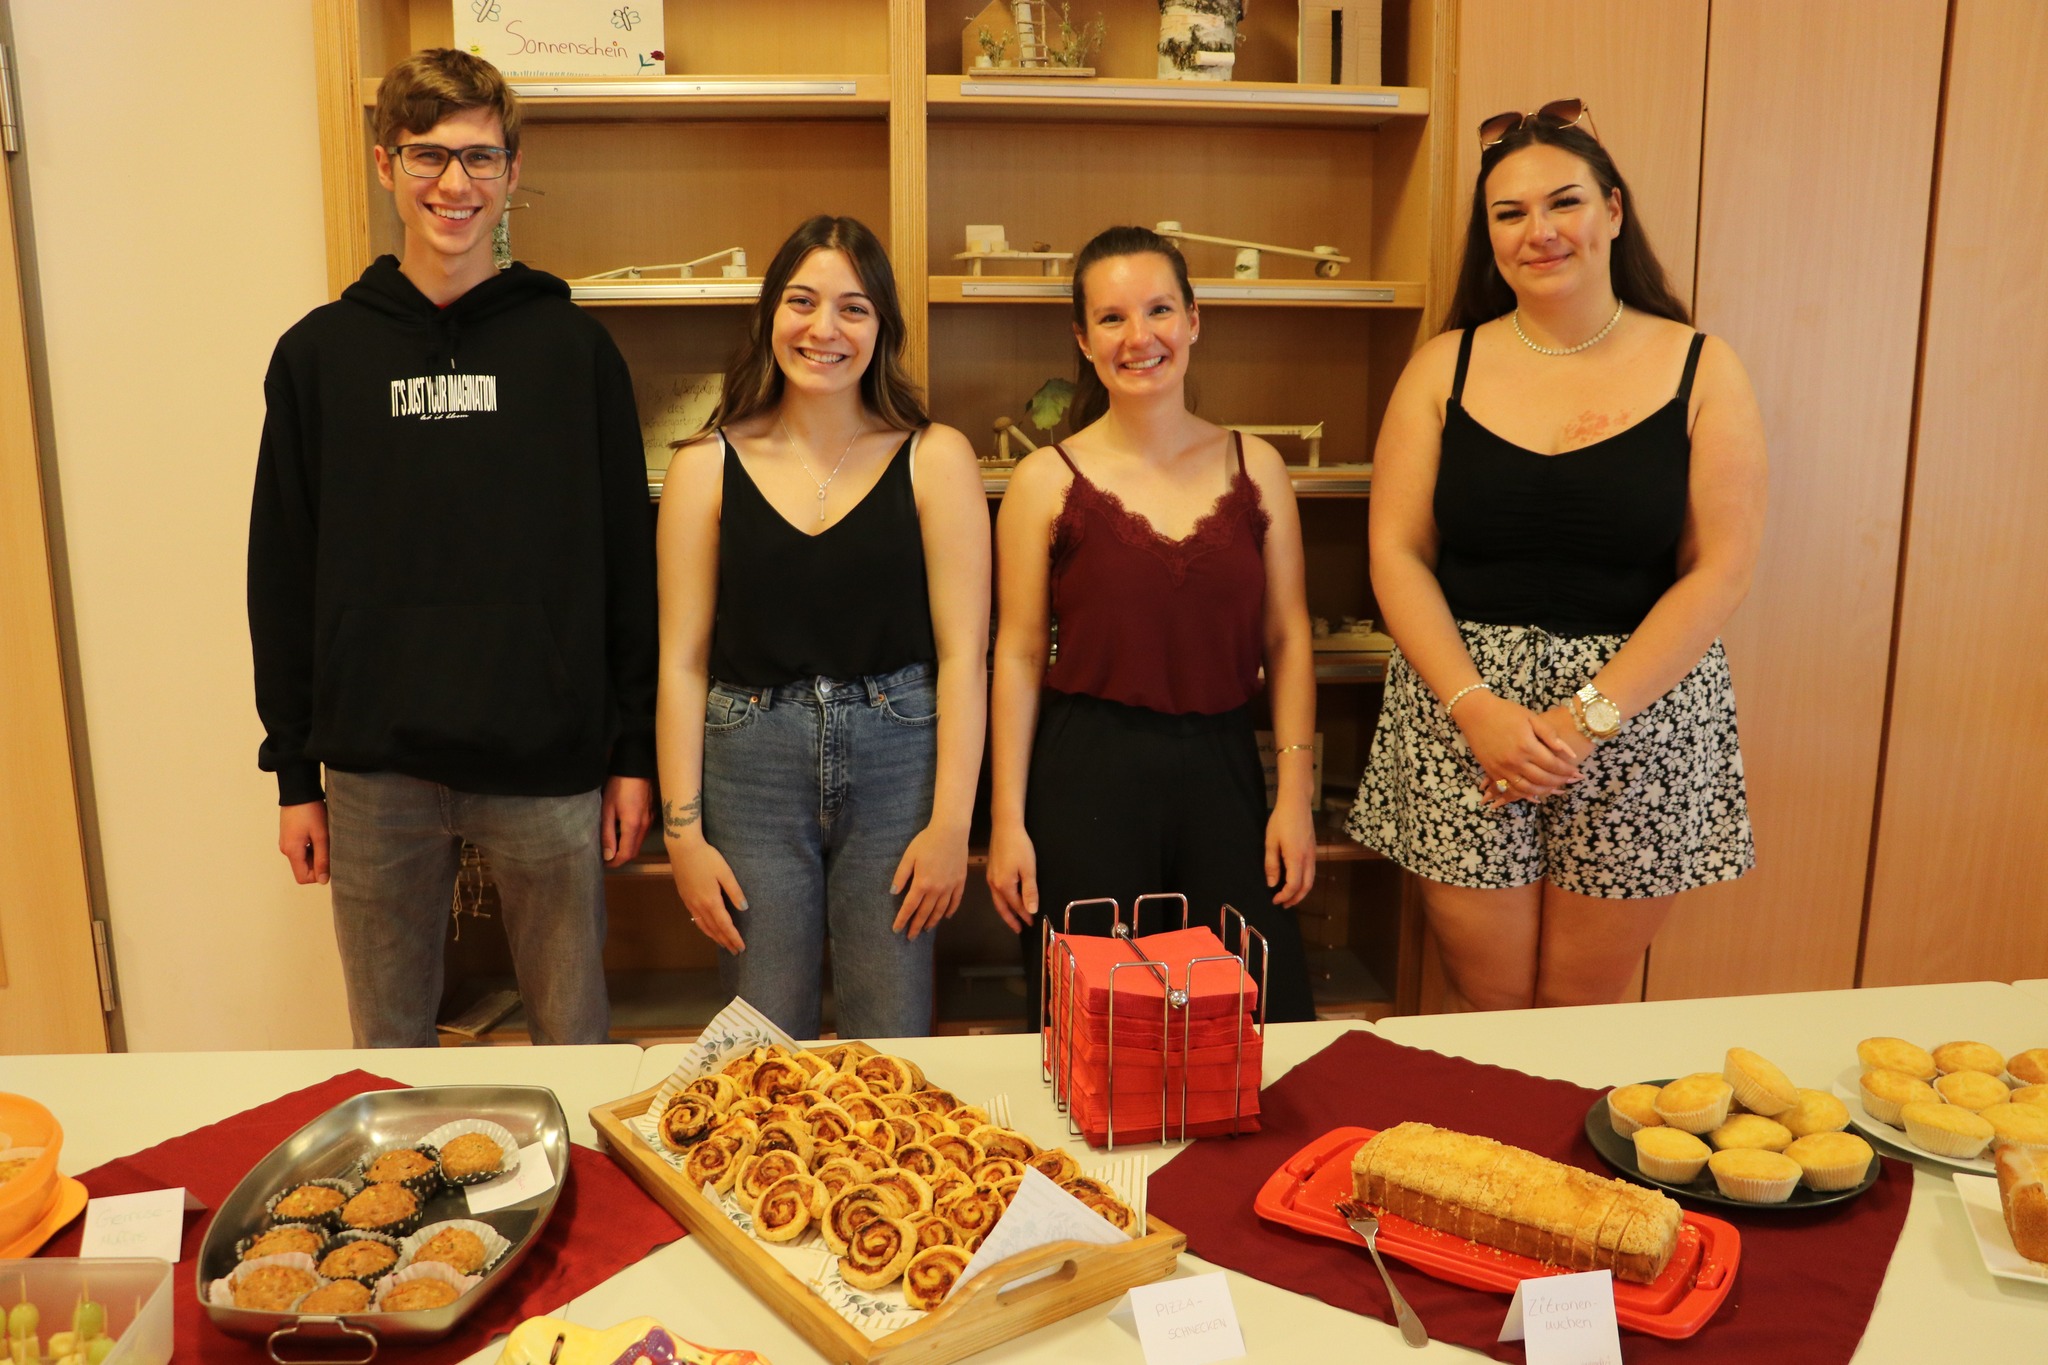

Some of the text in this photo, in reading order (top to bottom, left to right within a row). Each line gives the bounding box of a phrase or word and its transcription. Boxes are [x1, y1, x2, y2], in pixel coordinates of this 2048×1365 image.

[505, 20, 628, 58] Sonnenschein
[391, 374, 497, 417] IT'S JUST YOUR IMAGINATION
[667, 403, 685, 415] des
[1169, 1318, 1227, 1340] SCHNECKEN
